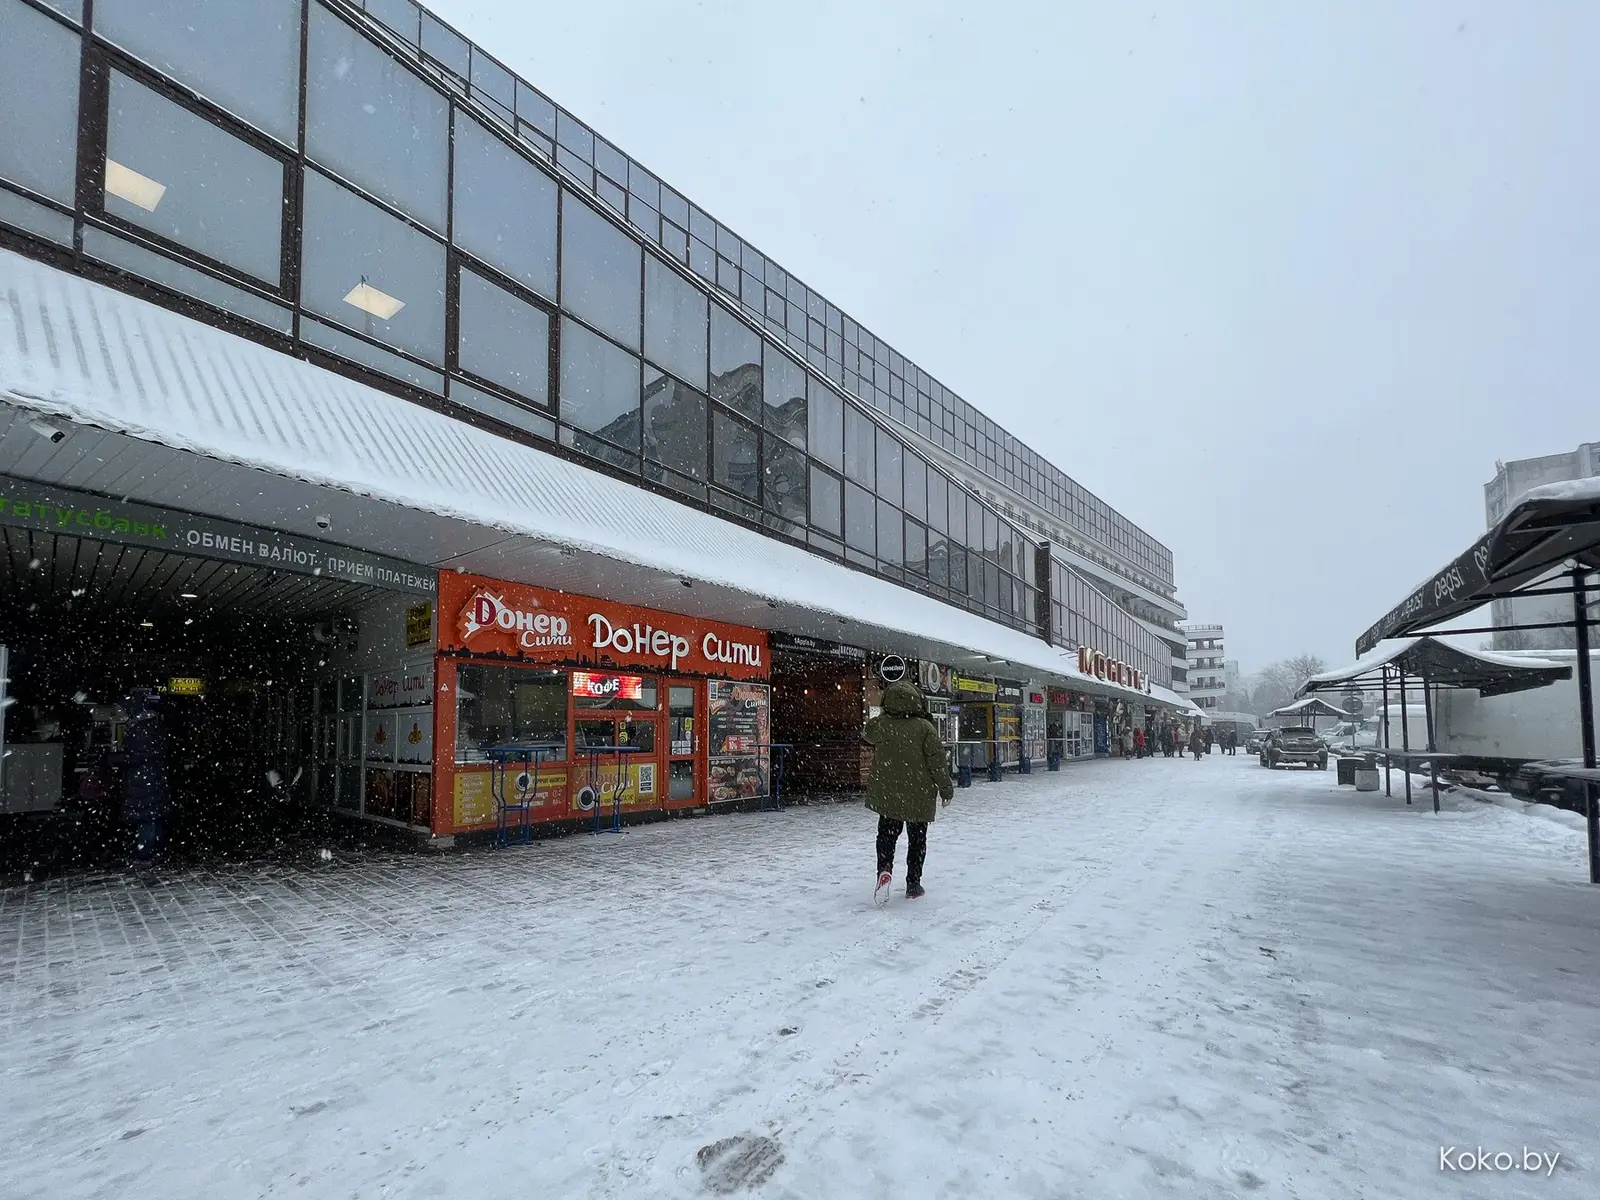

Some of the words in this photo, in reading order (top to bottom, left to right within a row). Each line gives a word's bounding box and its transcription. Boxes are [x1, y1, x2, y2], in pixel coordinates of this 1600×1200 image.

[186, 530, 254, 554] ОБМЕН
[258, 543, 317, 566] ВАЛЮТ
[328, 557, 373, 579] ПРИЕМ
[377, 568, 436, 592] ПЛАТЕЖЕЙ
[1434, 561, 1465, 606] pepsi
[475, 597, 568, 636] Донер
[521, 631, 573, 648] Сити
[588, 613, 690, 670] Донер
[703, 632, 762, 667] Сити
